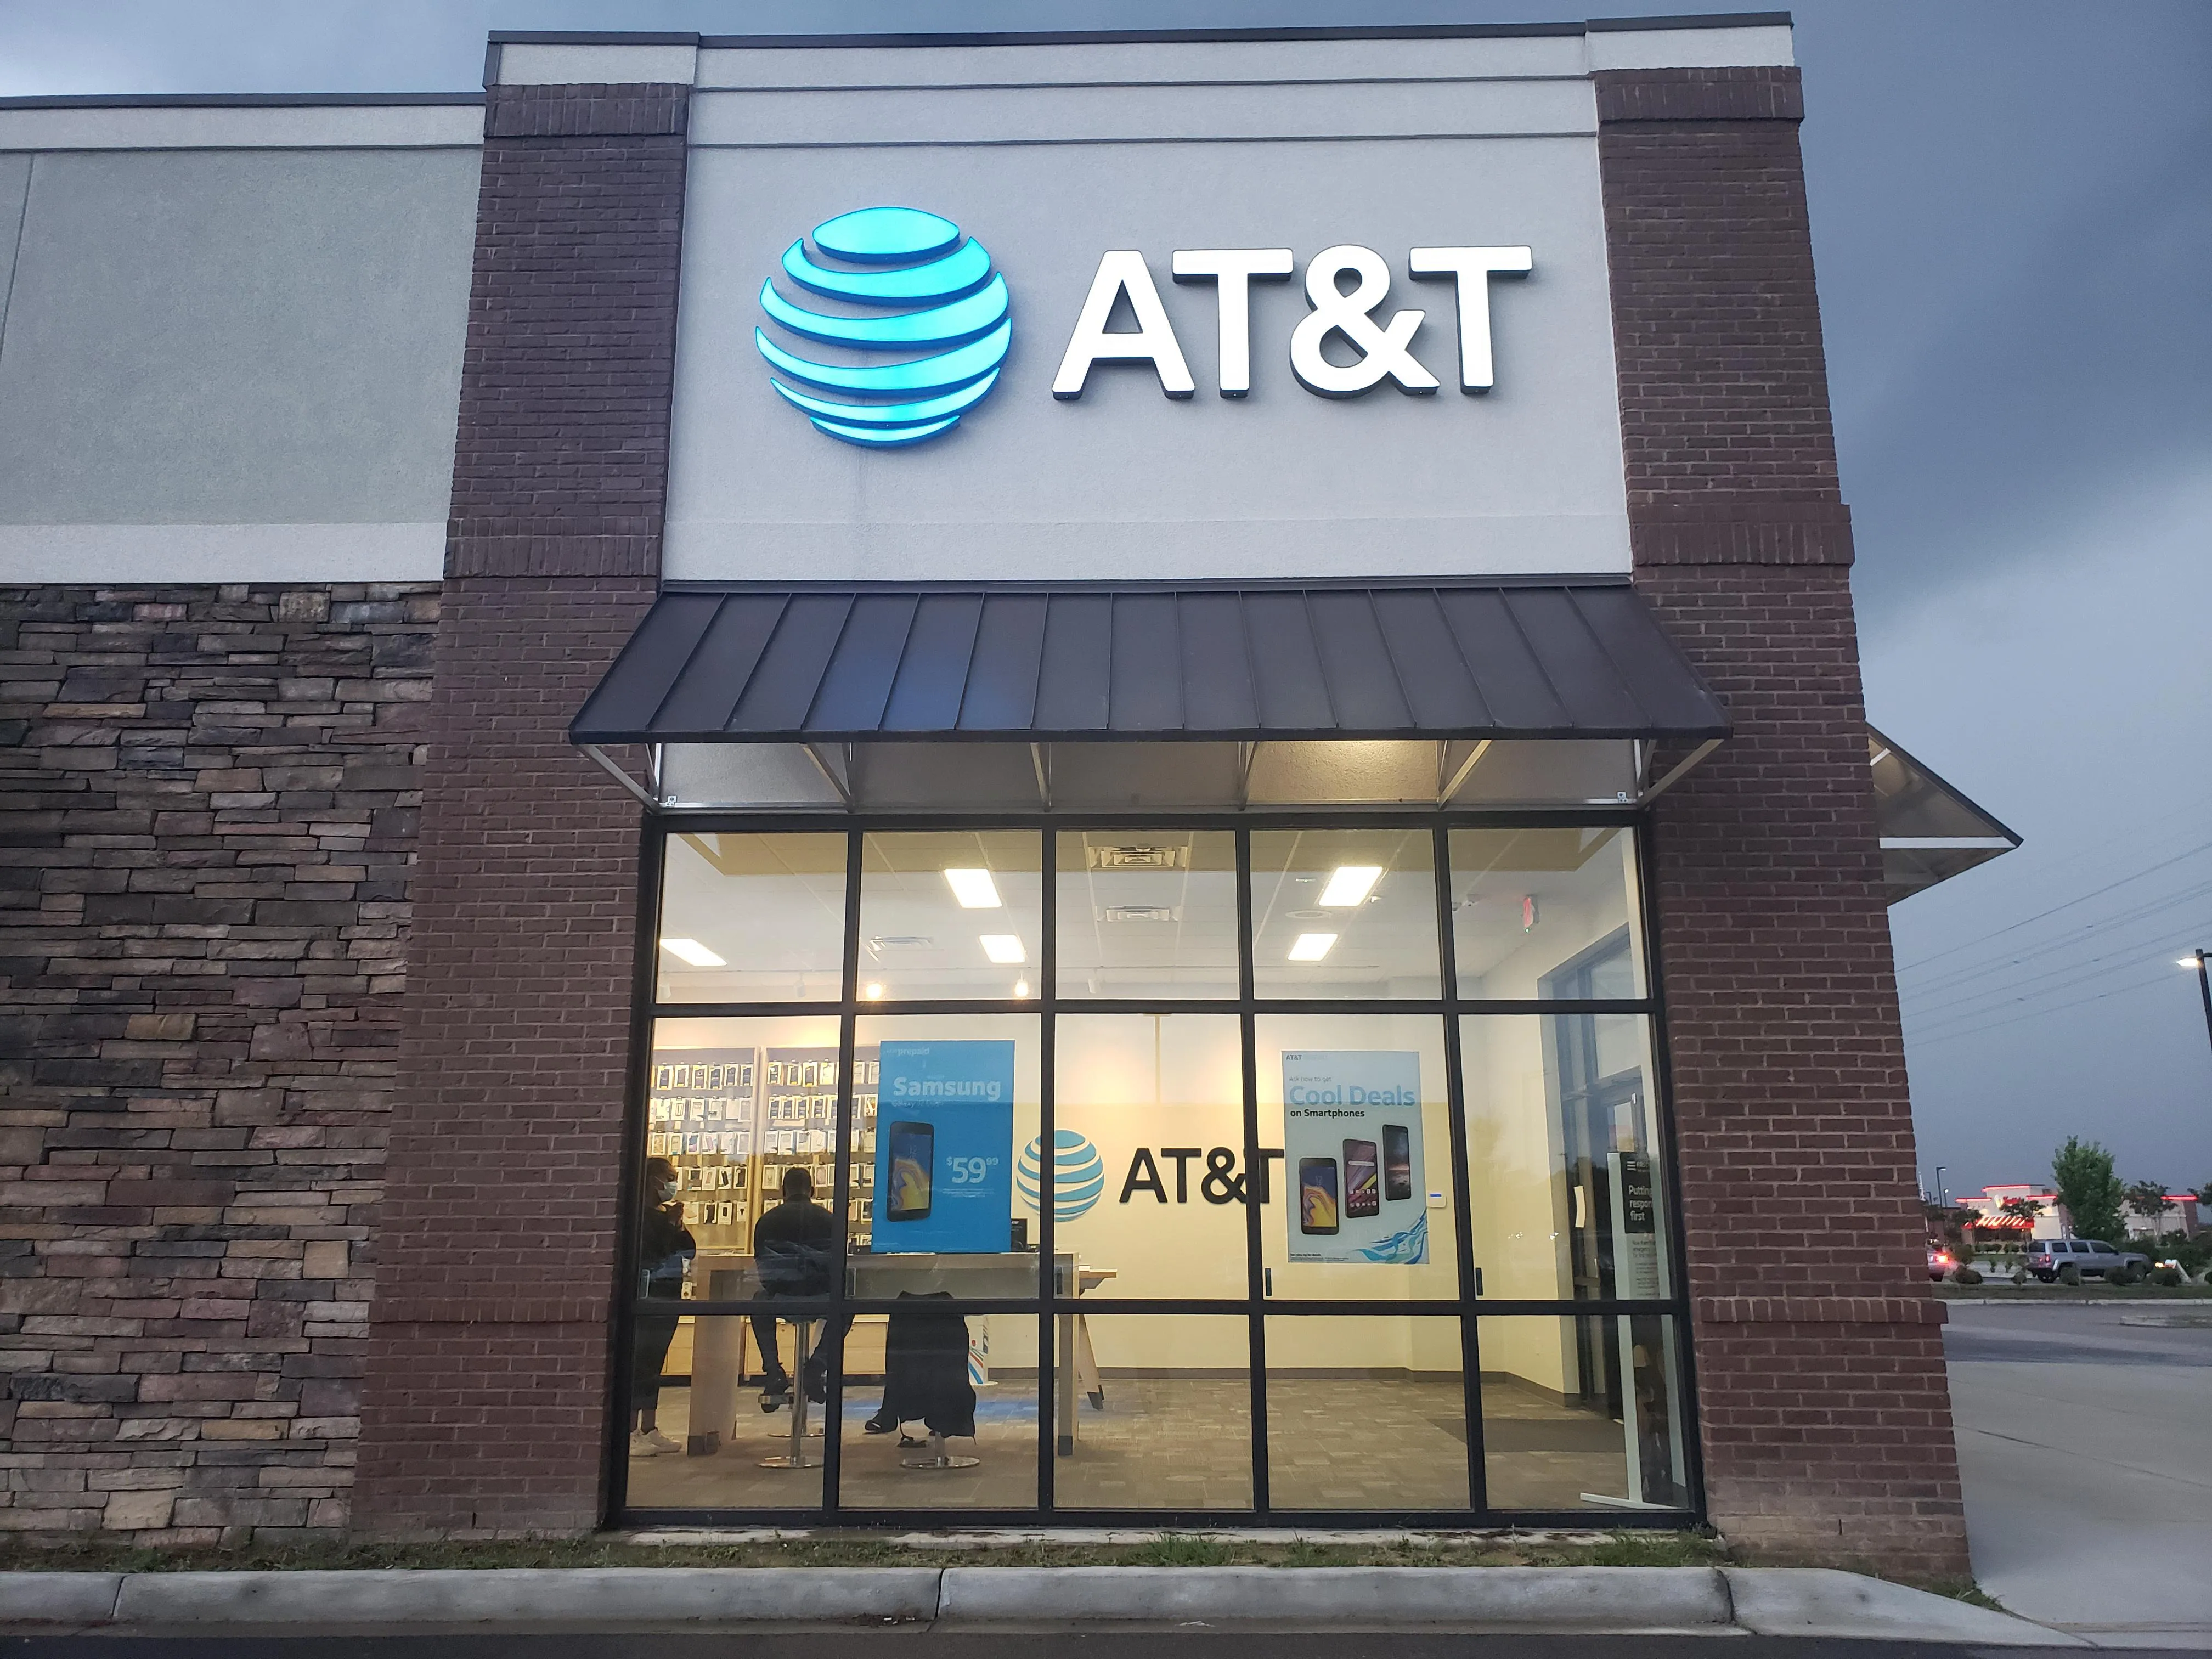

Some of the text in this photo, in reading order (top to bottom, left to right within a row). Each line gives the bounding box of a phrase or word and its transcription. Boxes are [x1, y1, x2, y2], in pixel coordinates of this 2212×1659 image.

[1052, 244, 1533, 400] AT&T
[893, 1076, 1002, 1102] Samsung
[1290, 1085, 1416, 1106] Cool Deals
[1304, 1109, 1365, 1119] Smartphones
[1119, 1147, 1285, 1204] AT&T
[1630, 1210, 1645, 1221] first
